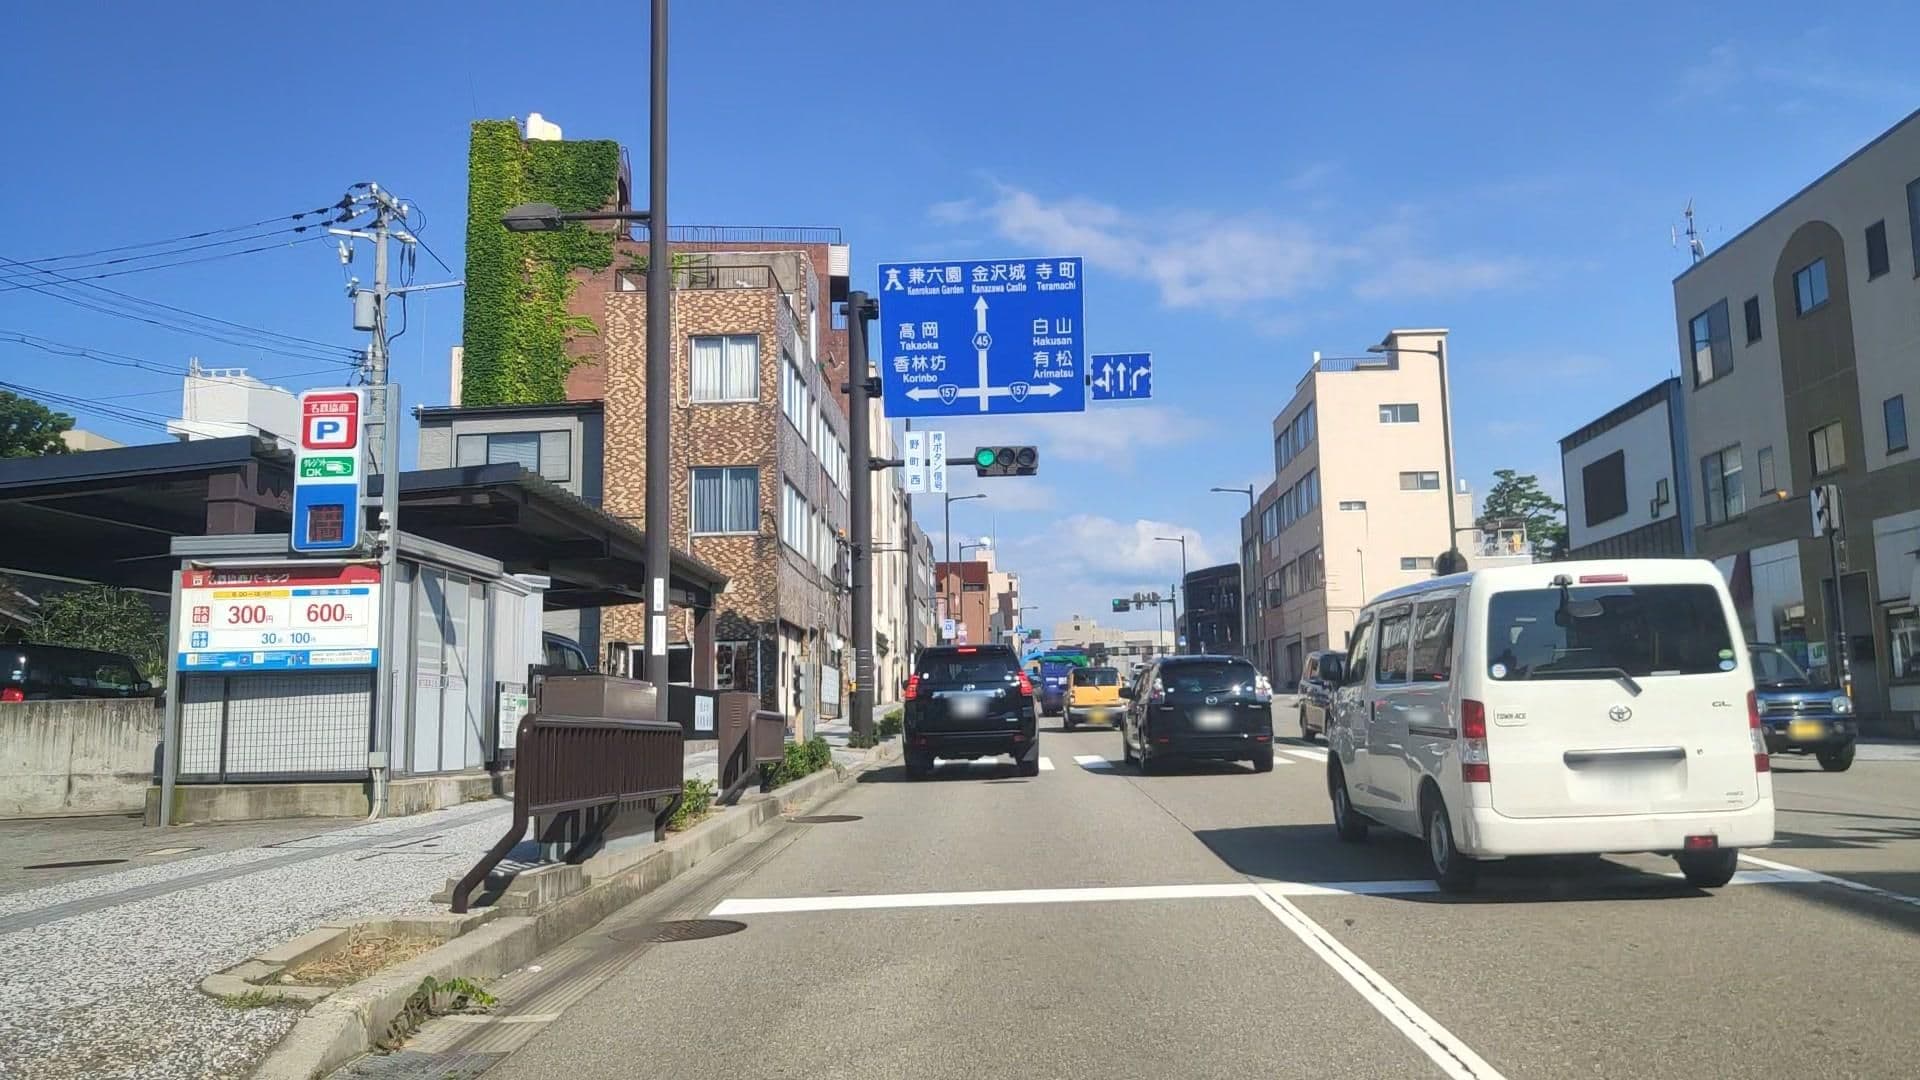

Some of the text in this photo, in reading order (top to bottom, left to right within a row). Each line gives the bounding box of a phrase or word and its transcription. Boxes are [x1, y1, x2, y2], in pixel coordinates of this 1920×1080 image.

[908, 266, 962, 285] 兼六園
[971, 264, 1026, 282] 金沢城
[1035, 262, 1075, 280] 寺町
[907, 285, 964, 296] Kenrokuen Garden
[972, 283, 1027, 294] Kanazawa Castle
[1037, 281, 1076, 291] Teramachi
[899, 322, 939, 340] 高岡
[1033, 317, 1072, 335] 白山
[900, 341, 939, 351] Takaoka
[976, 336, 989, 347] 45
[1033, 336, 1072, 346] Hakusan
[893, 355, 947, 373] 香林坊
[1033, 351, 1073, 368] 有松
[903, 373, 938, 383] Korinbo
[1033, 369, 1074, 379] Arimatsu
[940, 387, 956, 398] 157
[1012, 384, 1026, 396] 157
[317, 421, 340, 440] P
[909, 439, 921, 486] 野町西
[932, 432, 943, 492] 押ボタン信号
[306, 468, 322, 477] OK
[1711, 700, 1733, 708] GL
